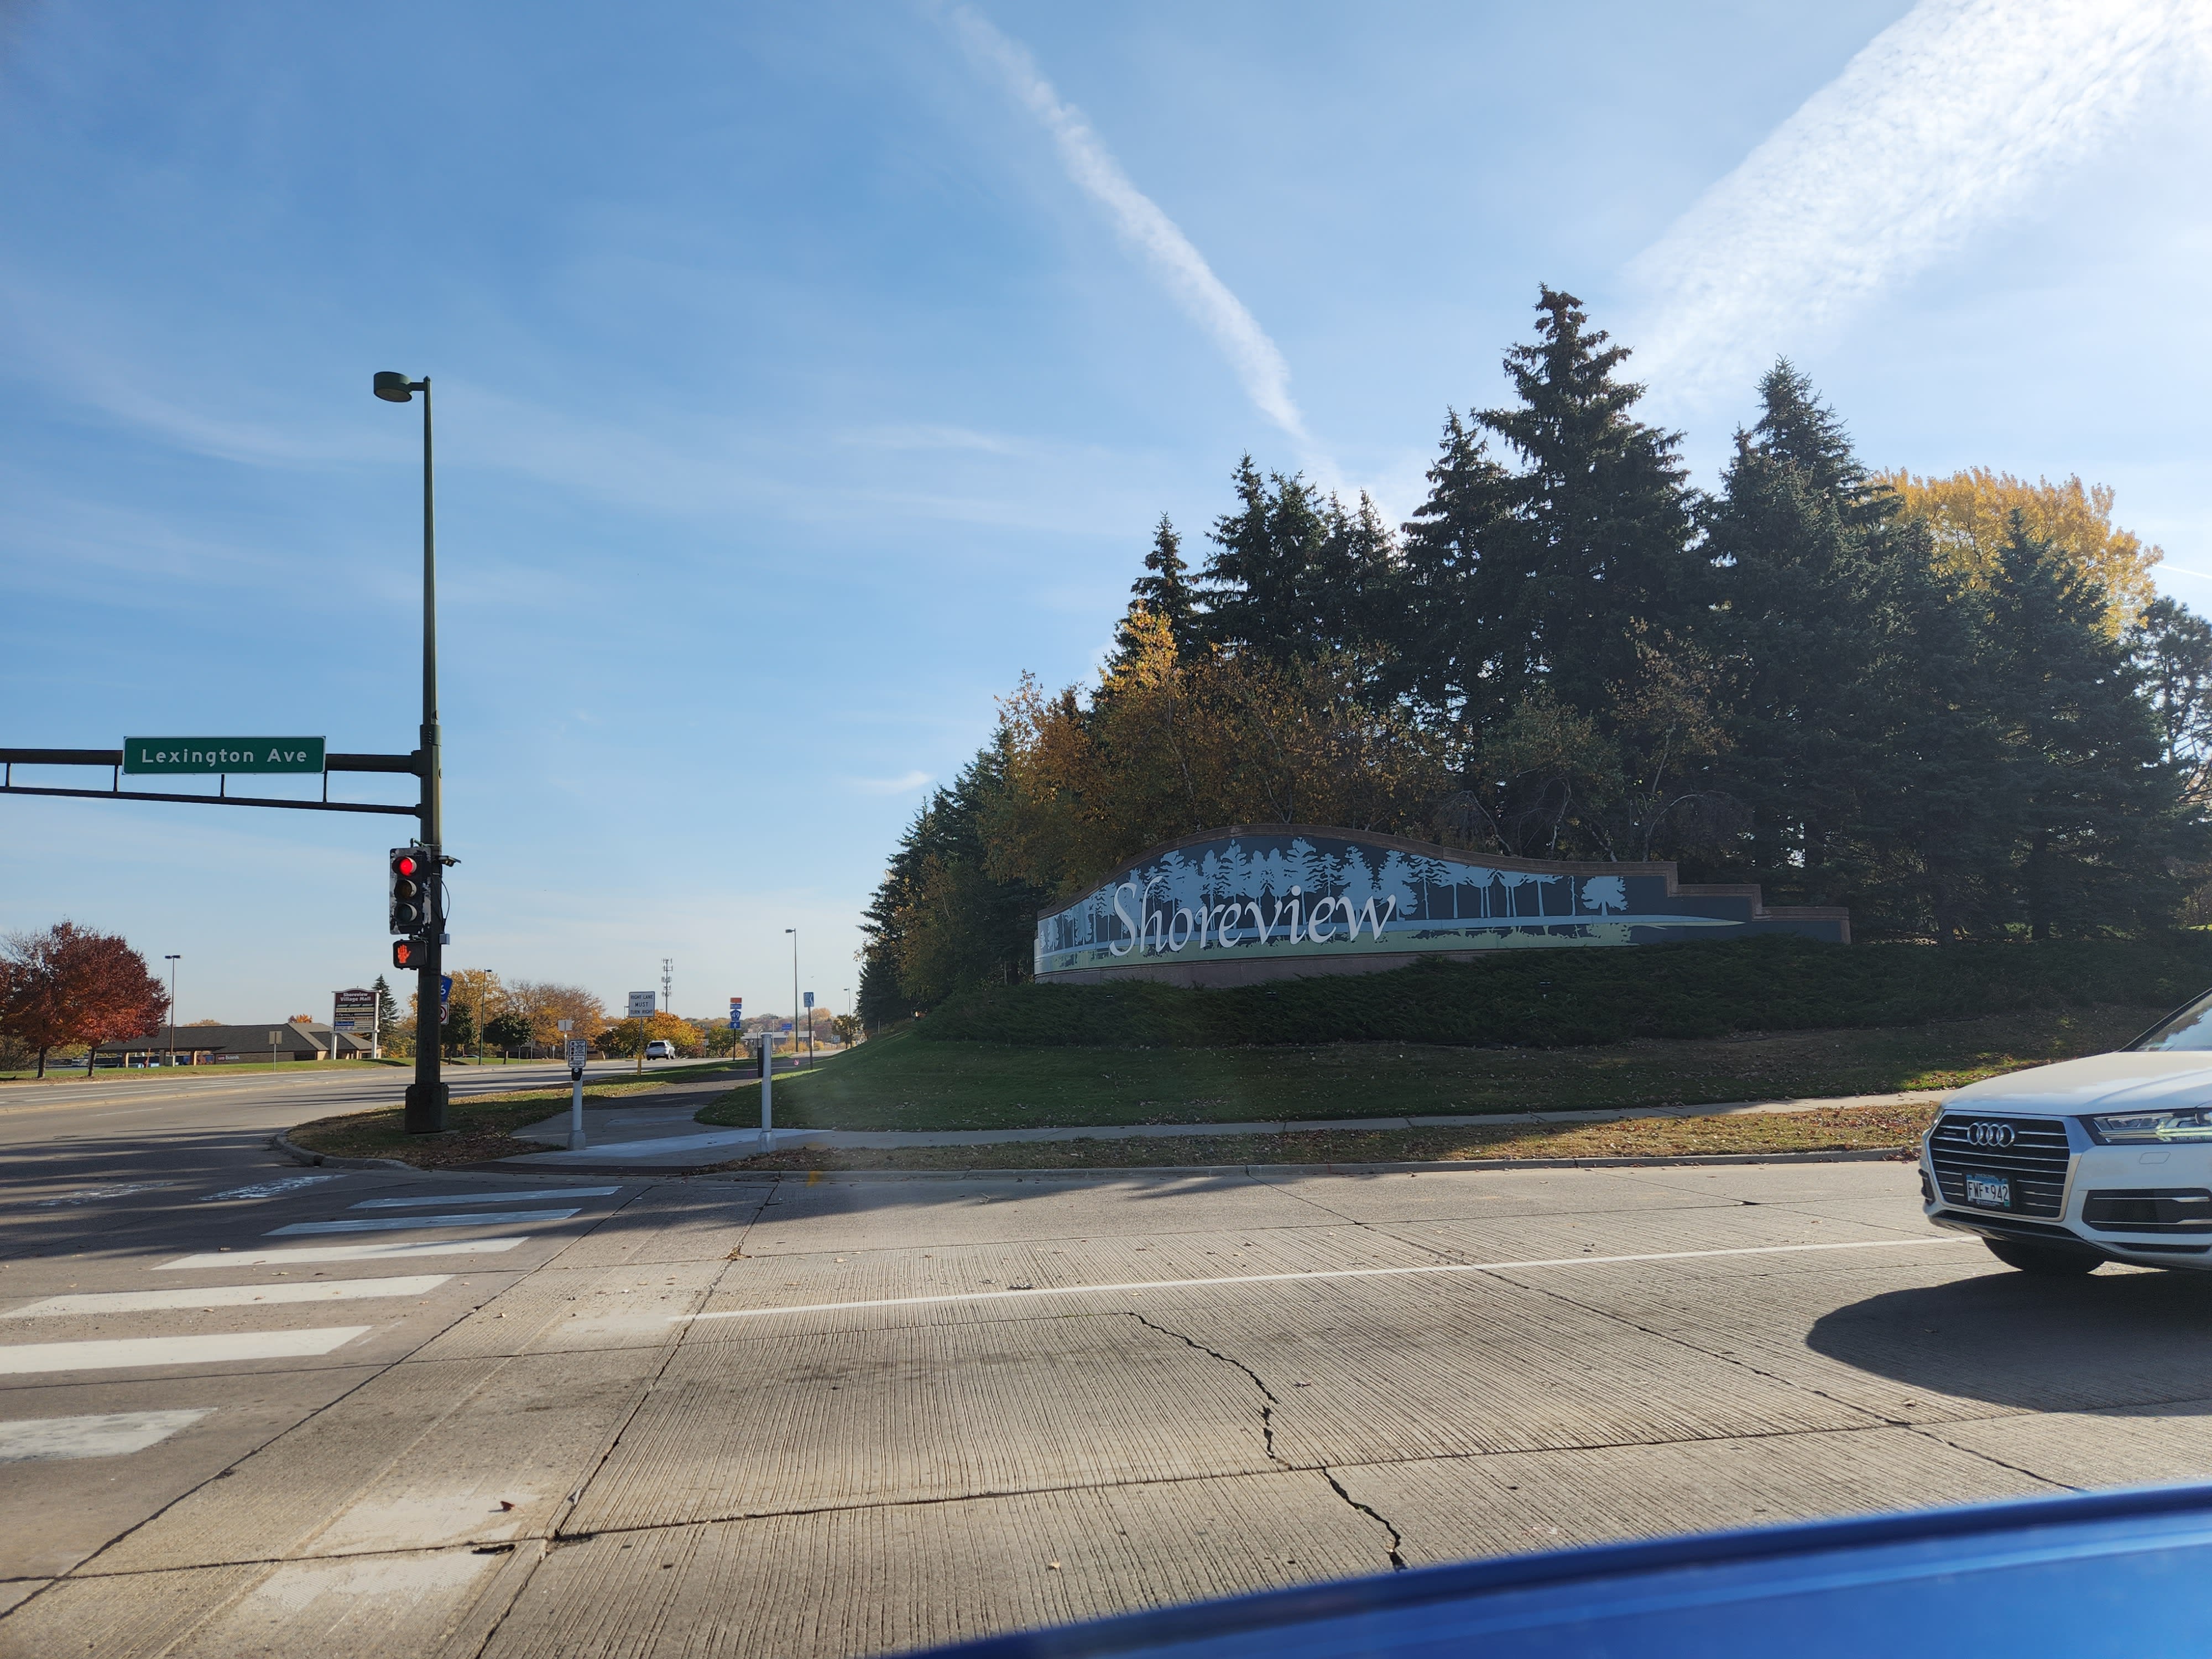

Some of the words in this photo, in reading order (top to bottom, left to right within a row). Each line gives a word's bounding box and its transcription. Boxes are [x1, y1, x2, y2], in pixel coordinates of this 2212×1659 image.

[142, 748, 254, 767] Lexington
[267, 748, 307, 763] Ave
[1108, 875, 1397, 957] Shoreview
[1991, 1185, 2008, 1202] 942
